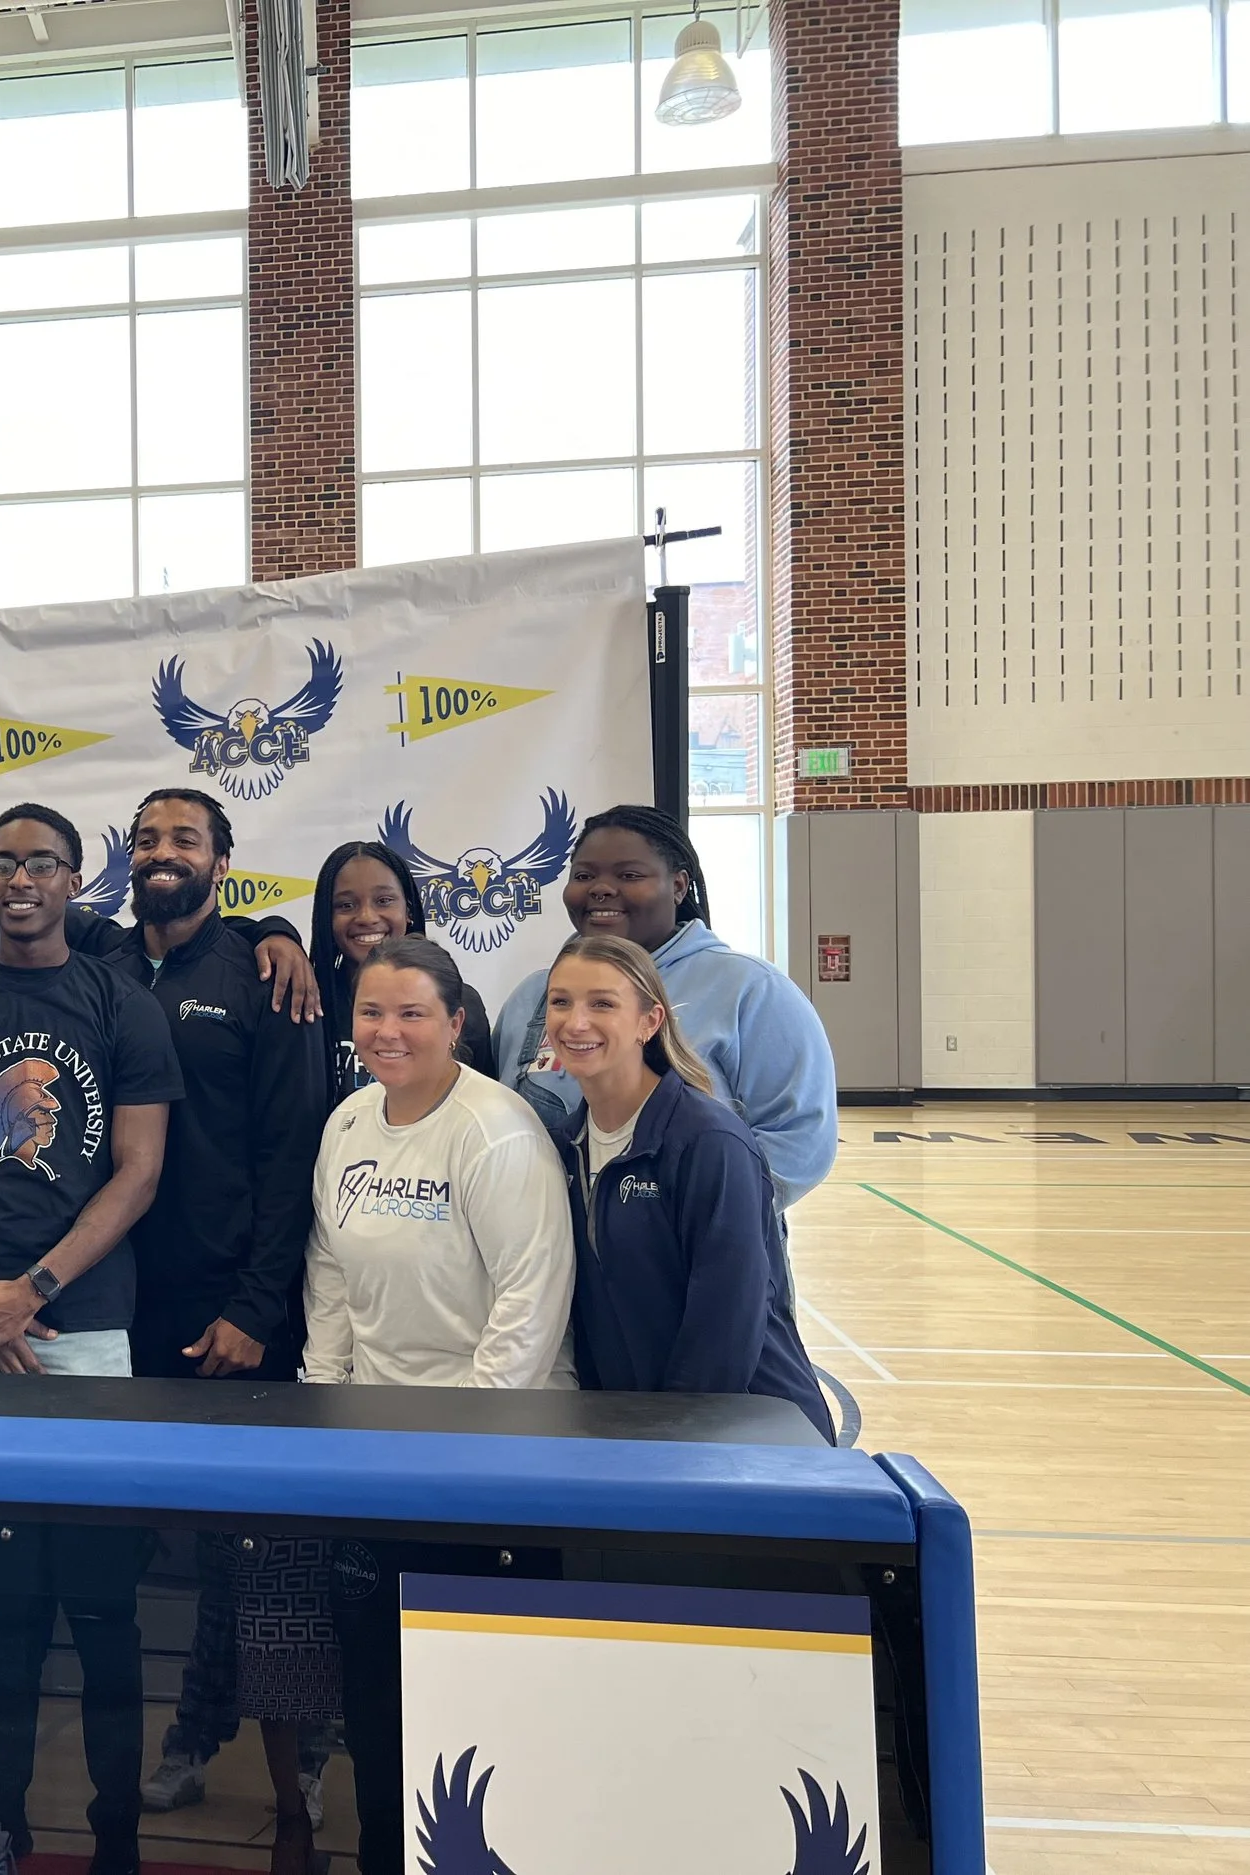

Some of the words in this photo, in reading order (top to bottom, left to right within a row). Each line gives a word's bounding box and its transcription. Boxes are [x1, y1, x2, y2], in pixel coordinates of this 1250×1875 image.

[419, 685, 497, 725] 100%
[189, 729, 310, 774] ACCE
[807, 751, 838, 774] EXIT
[216, 877, 283, 912] 00%
[193, 1004, 227, 1016] HARLEM
[54, 1040, 104, 1165] UNIVERSITY
[366, 1177, 450, 1203] HARLEM
[361, 1197, 450, 1222] LACROSSE
